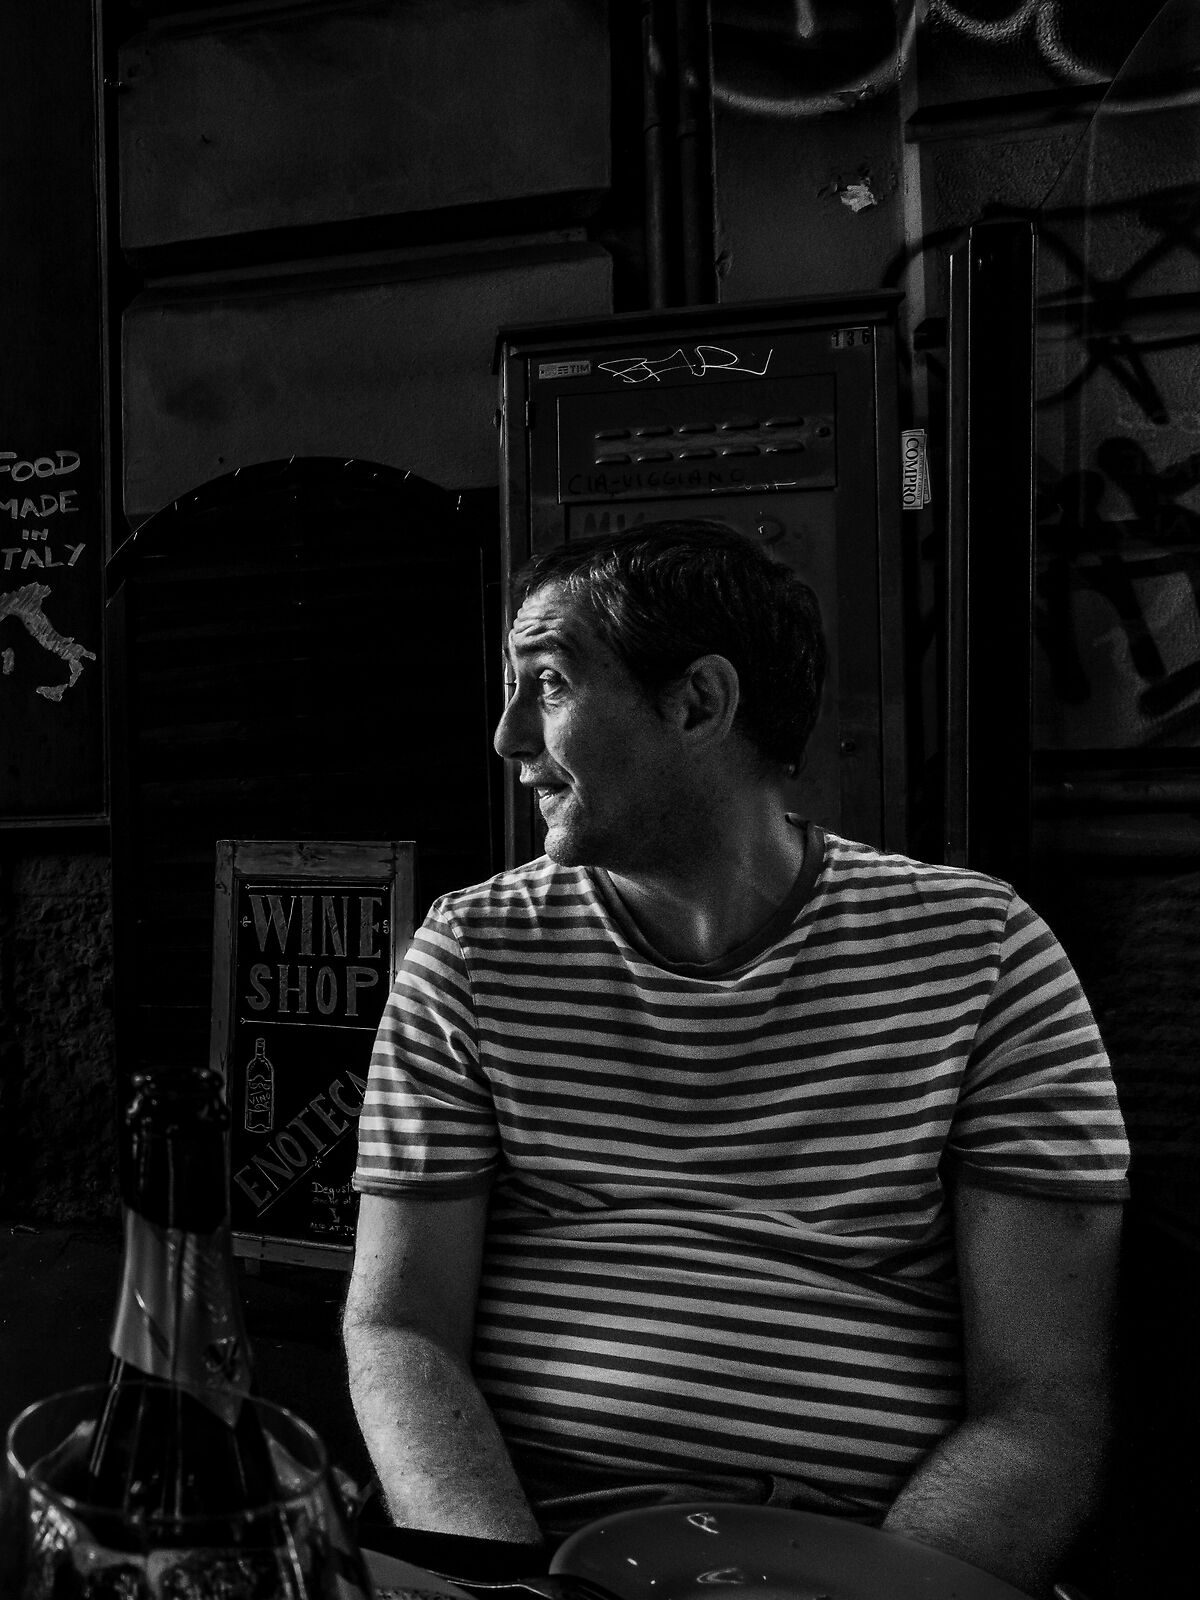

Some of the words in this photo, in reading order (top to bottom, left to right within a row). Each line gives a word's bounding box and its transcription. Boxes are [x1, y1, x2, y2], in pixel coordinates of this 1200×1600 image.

[903, 437, 920, 505] COMPRO
[21, 528, 49, 541] IN
[248, 895, 383, 959] WINE
[245, 962, 380, 1017] SHOP
